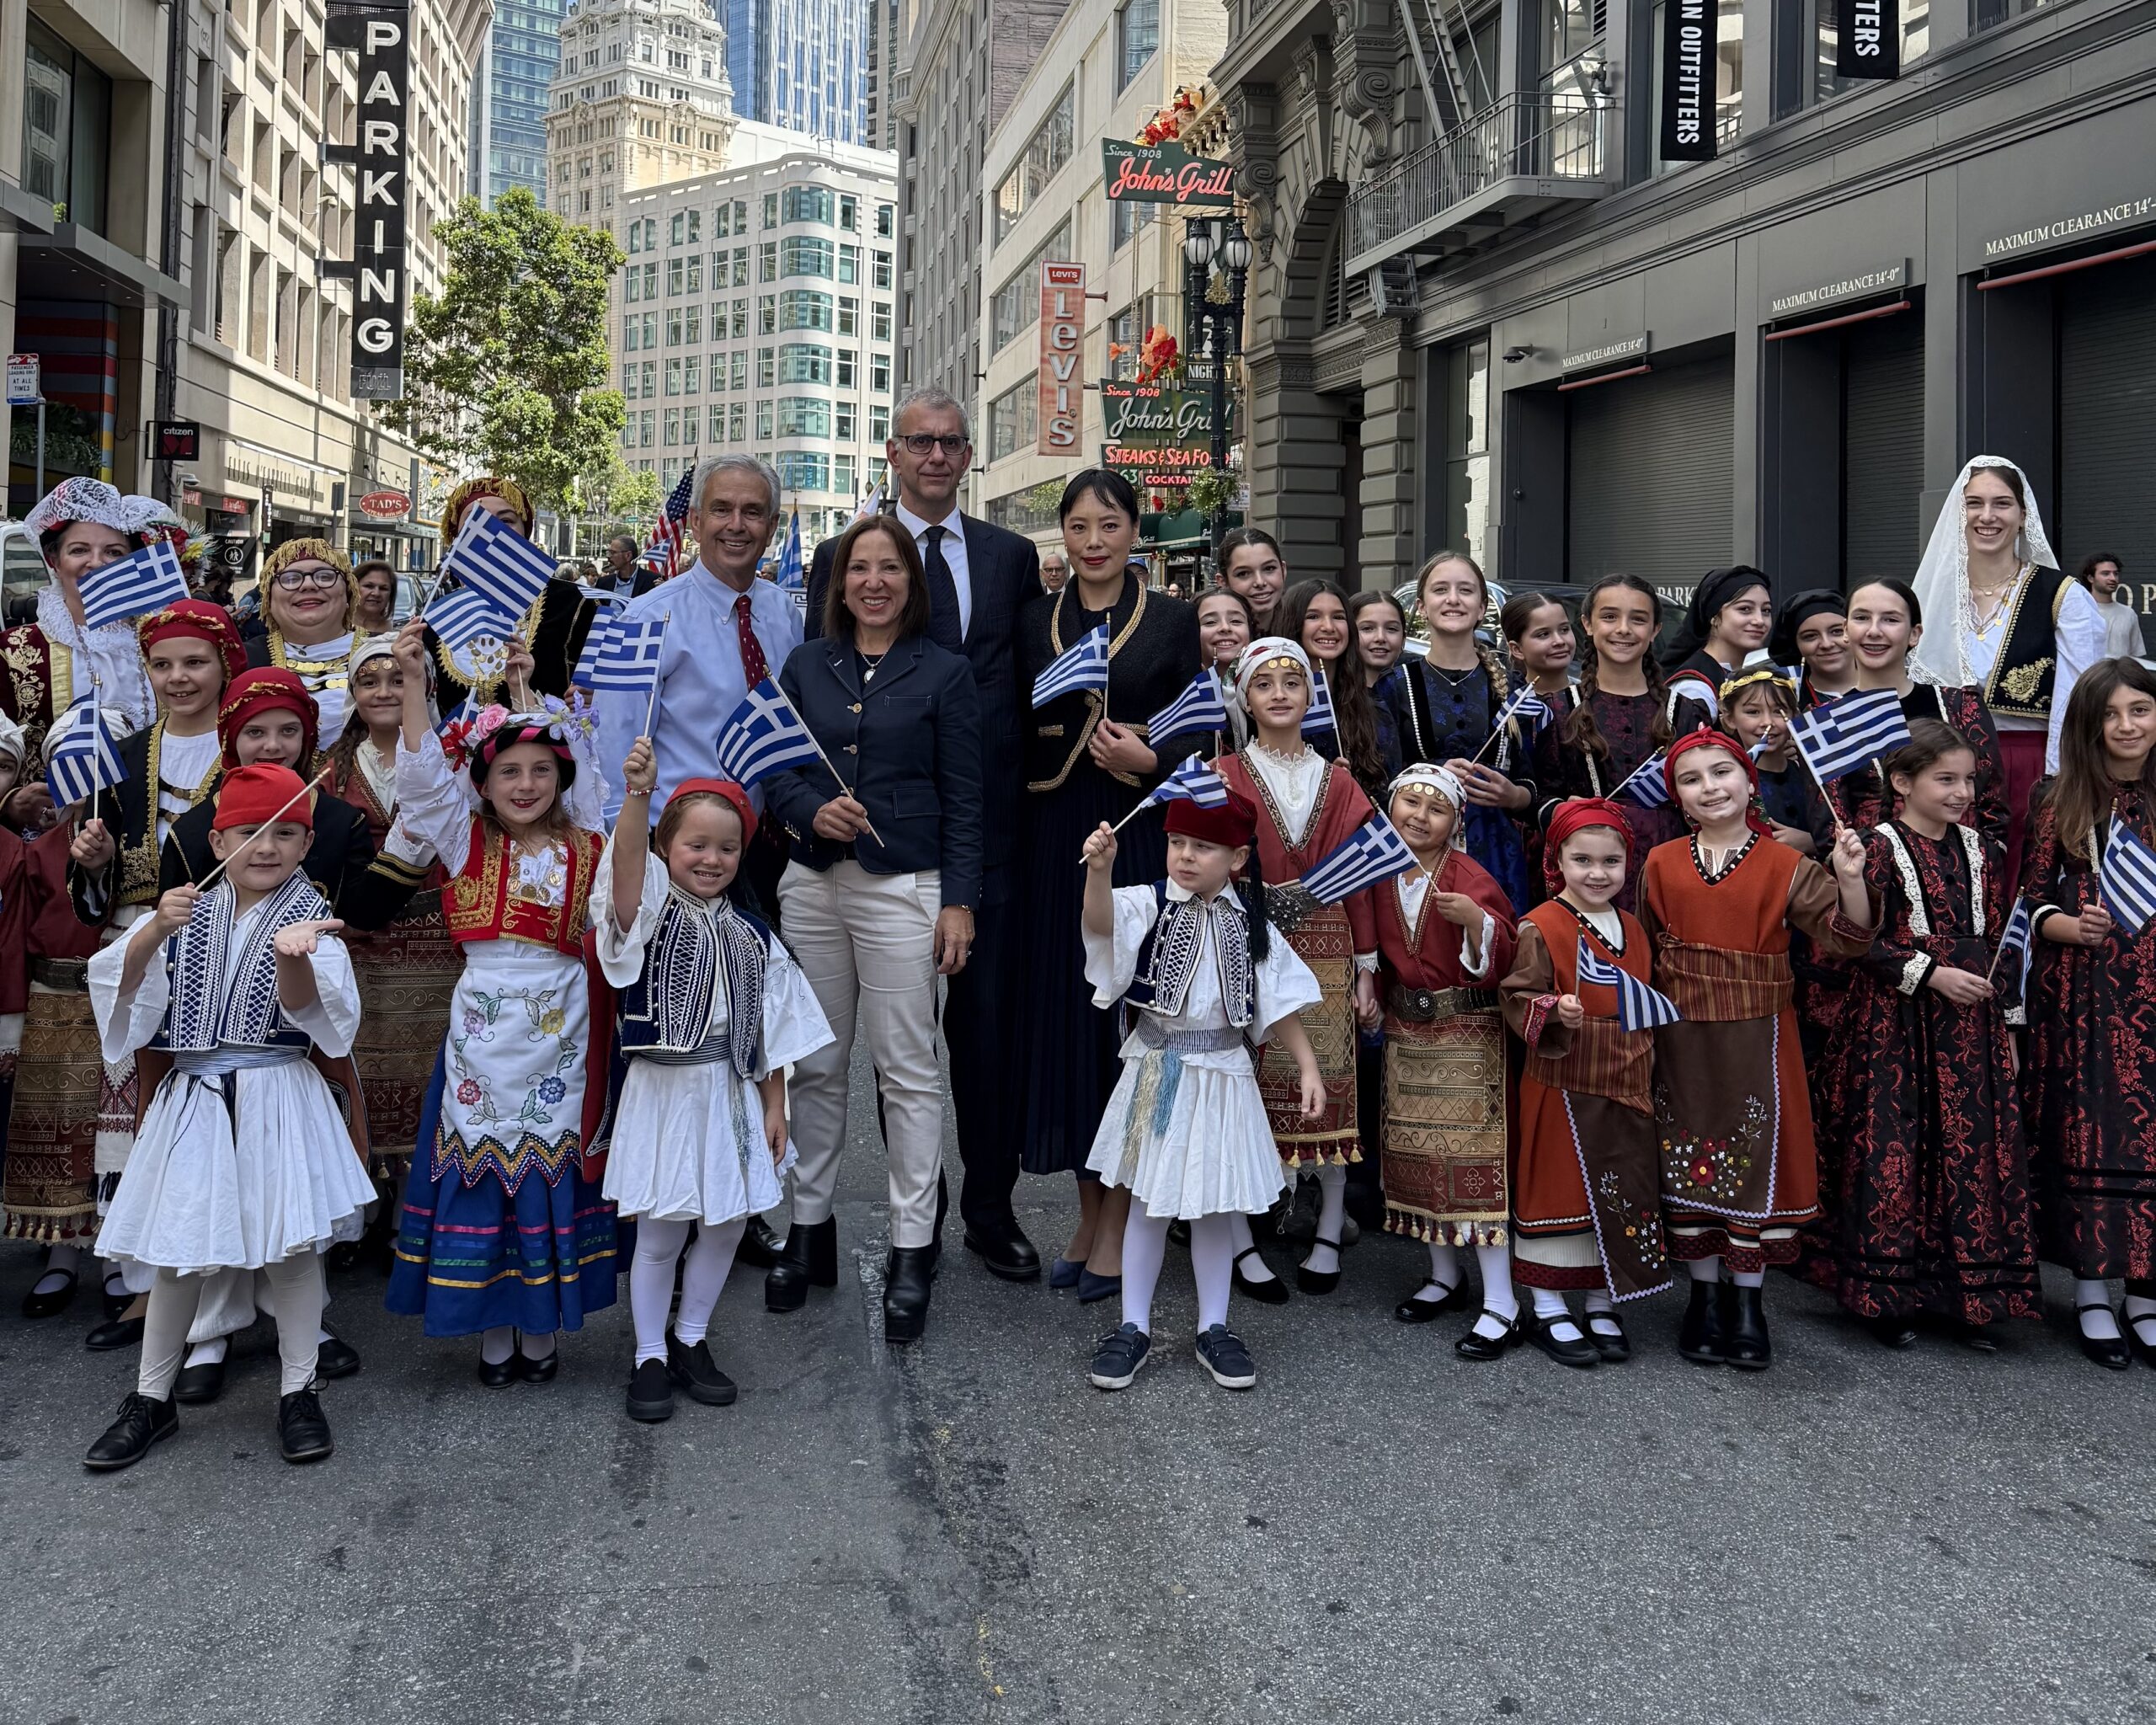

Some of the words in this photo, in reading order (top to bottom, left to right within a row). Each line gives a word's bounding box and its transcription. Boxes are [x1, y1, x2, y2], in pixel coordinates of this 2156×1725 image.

[1677, 26, 1702, 144] OUTFITTERS
[1105, 144, 1134, 158] Since
[1137, 149, 1162, 160] 1908
[357, 20, 402, 354] PARKING
[1109, 157, 1175, 198] John's
[1177, 162, 1233, 202] Grill
[1985, 225, 2049, 255] MAXIMUM
[2051, 202, 2132, 238] CLEARANCE
[1772, 289, 1817, 312] MAXIMUM
[1818, 274, 1874, 300] CLEARANCE
[1562, 351, 1592, 368] MAXIMUM
[1592, 341, 1627, 360] CLEARANCE
[1188, 364, 1232, 379] NIGHY
[1102, 384, 1132, 396] Since
[1134, 387, 1161, 398] 1908
[1109, 397, 1175, 438] John's
[163, 426, 194, 435] citizen
[1105, 446, 1157, 464] STEAKS
[1120, 469, 1138, 483] 63
[1145, 475, 1195, 484] COCKTAI
[369, 499, 402, 509] TAD'S
